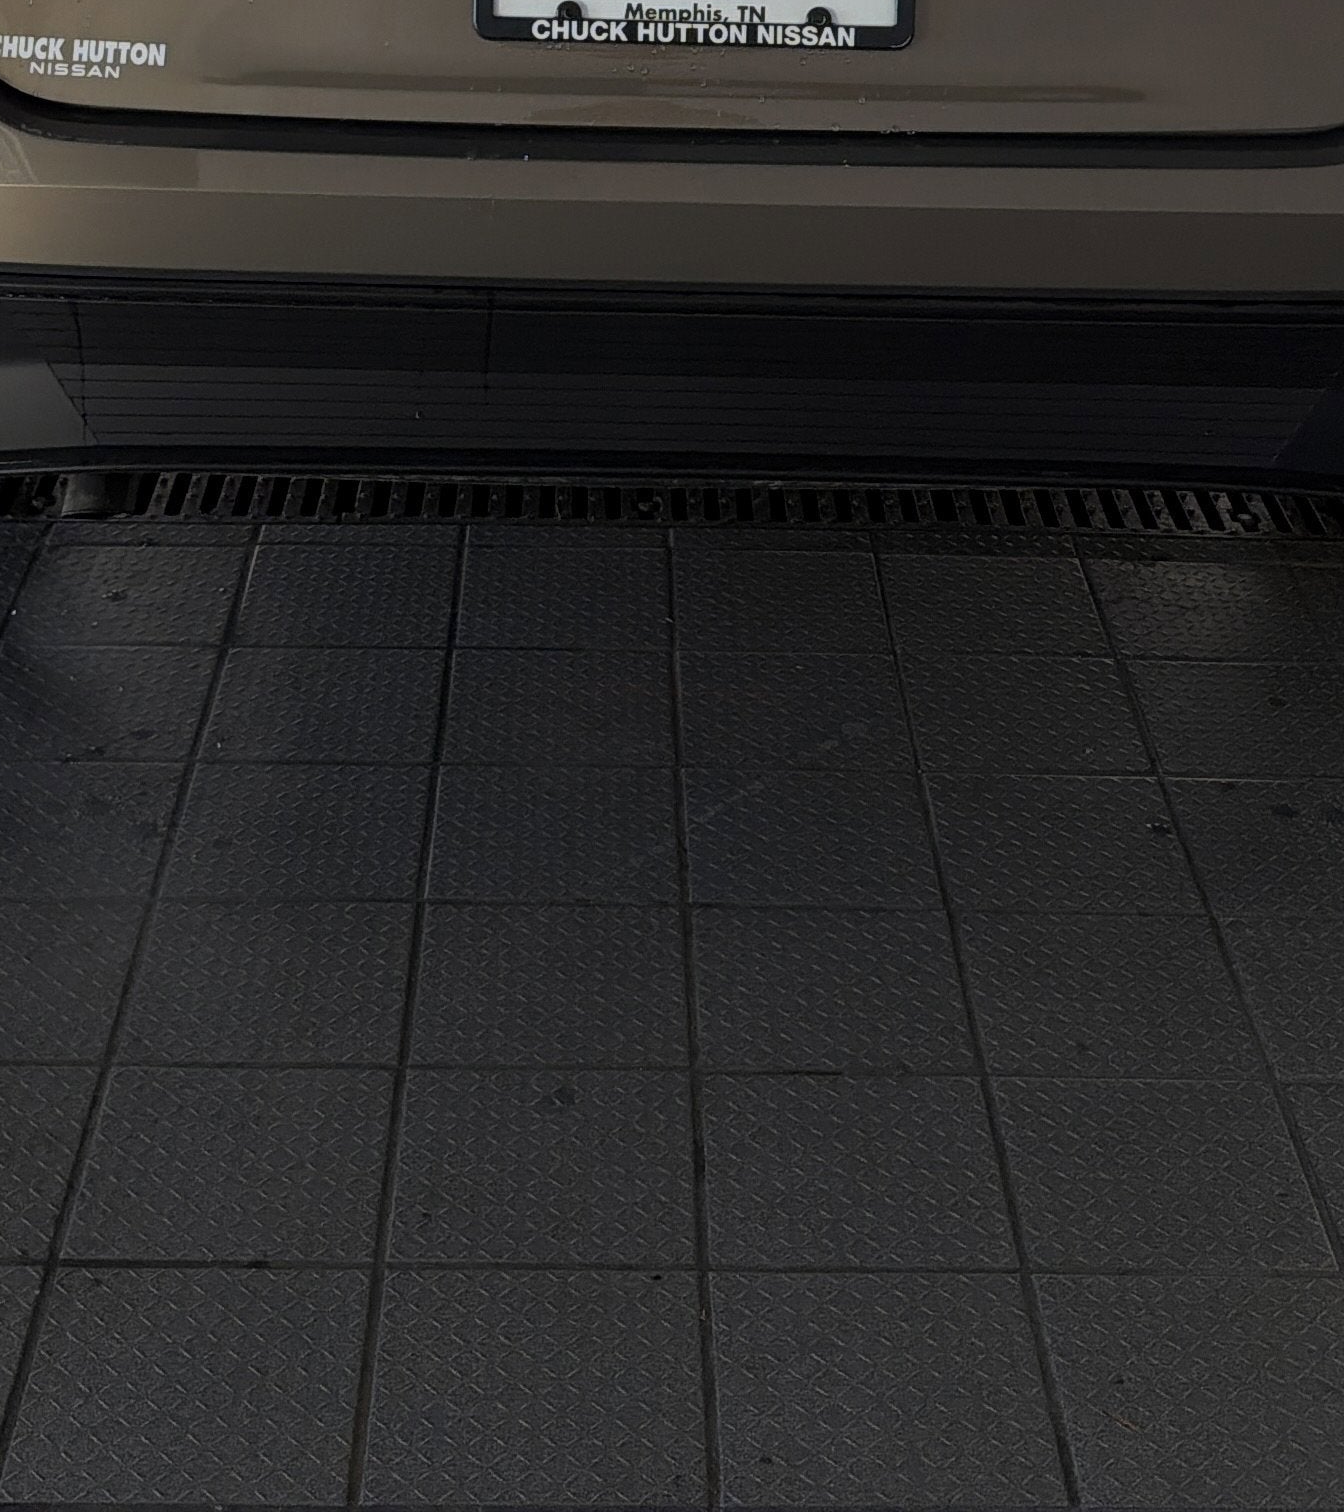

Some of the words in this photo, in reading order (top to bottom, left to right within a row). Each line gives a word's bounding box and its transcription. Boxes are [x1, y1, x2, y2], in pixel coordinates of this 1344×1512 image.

[625, 3, 729, 22] Memphis,
[737, 6, 766, 23] TN
[531, 20, 628, 42] CHUCK
[637, 22, 748, 45] HUTTON
[756, 25, 855, 47] NISSAN
[72, 38, 166, 67] HUTTON
[29, 61, 121, 79] NISSAN
